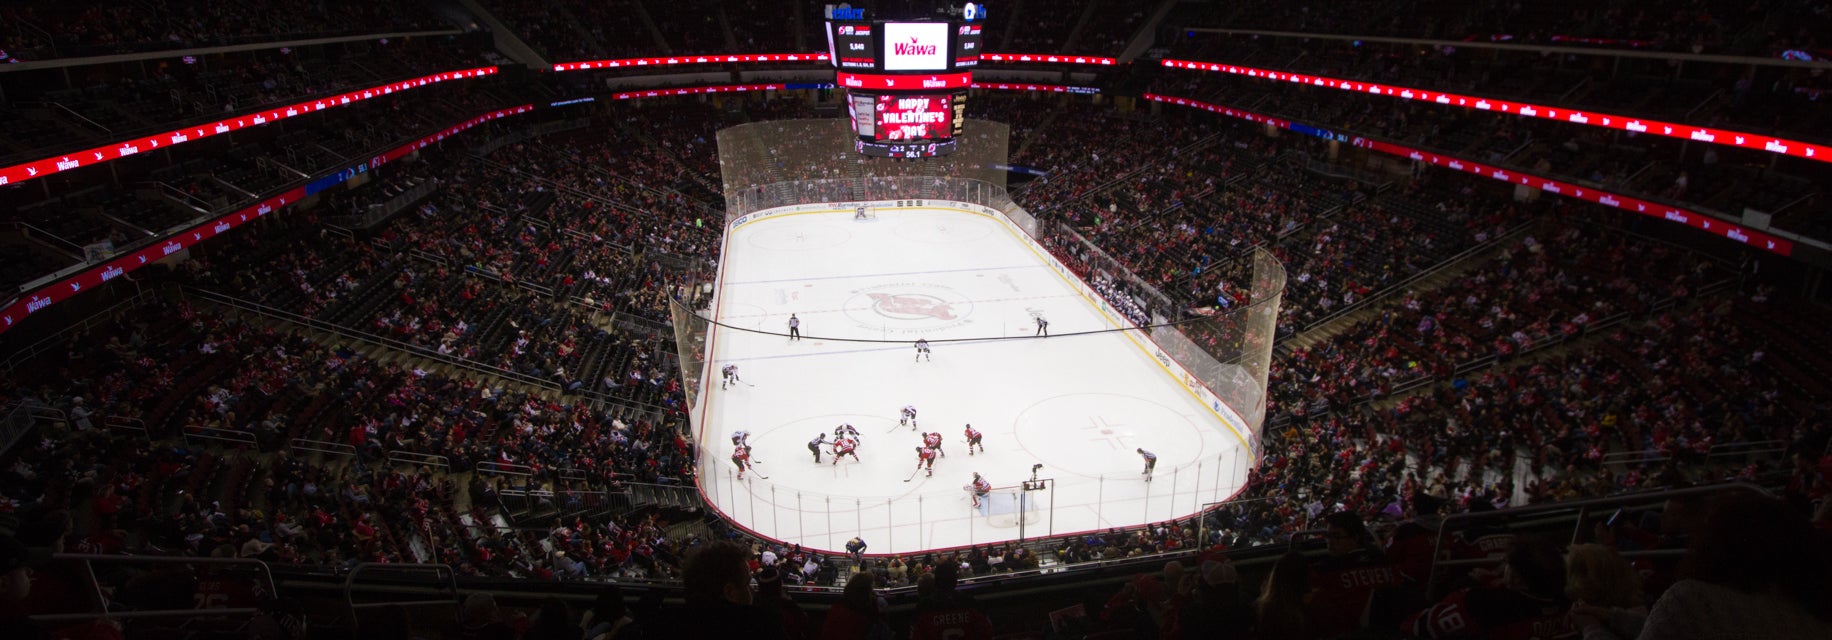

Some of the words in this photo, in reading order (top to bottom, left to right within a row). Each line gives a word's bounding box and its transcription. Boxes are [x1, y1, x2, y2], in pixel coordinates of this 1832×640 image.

[894, 43, 937, 56] Wawa
[845, 78, 863, 87] Wawa
[923, 79, 946, 88] Wawa
[898, 98, 930, 110] HAPPY
[882, 112, 945, 124] VALENTINE'S
[904, 125, 926, 137] DAY
[119, 146, 138, 157] Wawa
[57, 160, 80, 172] Wawa
[162, 242, 182, 255] Wawa
[101, 266, 123, 282] Wawa
[27, 296, 52, 313] Wawa
[933, 611, 970, 626] GREENE
